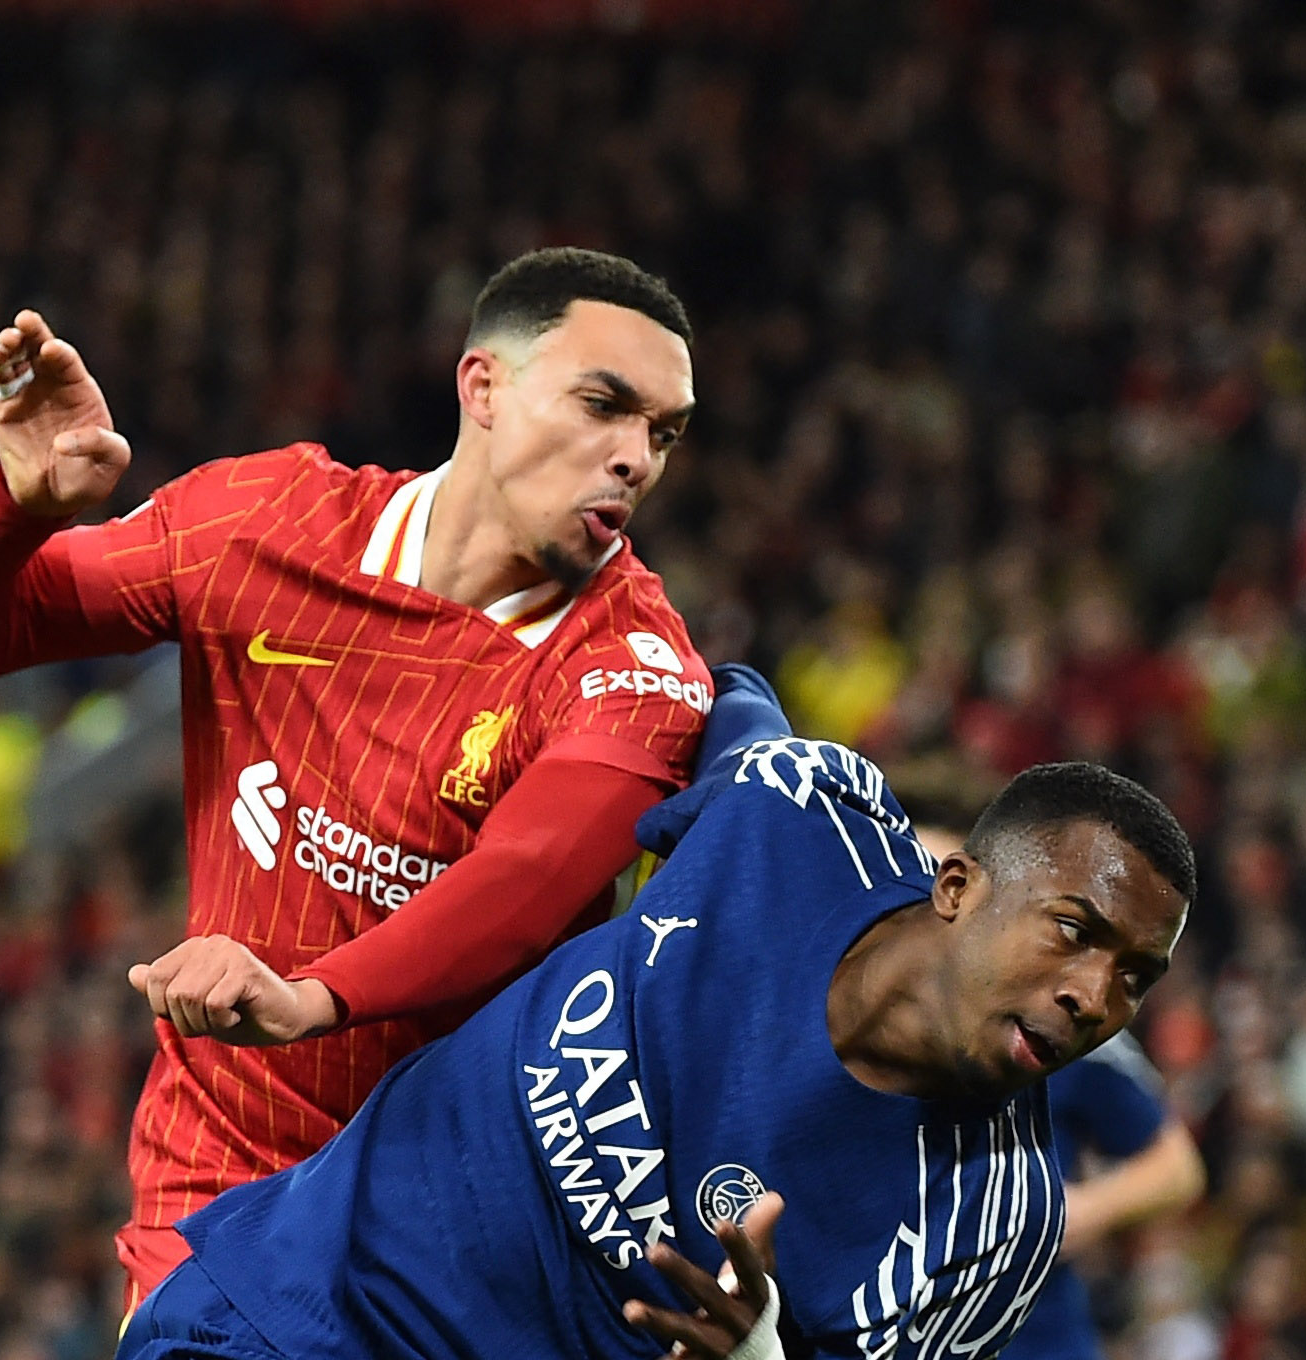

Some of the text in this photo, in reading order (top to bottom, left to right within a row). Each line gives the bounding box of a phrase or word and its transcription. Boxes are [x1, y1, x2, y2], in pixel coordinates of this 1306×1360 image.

[294, 839, 420, 911] charte
[523, 1064, 644, 1271] AIRWAYS
[549, 969, 676, 1248] QATAR
